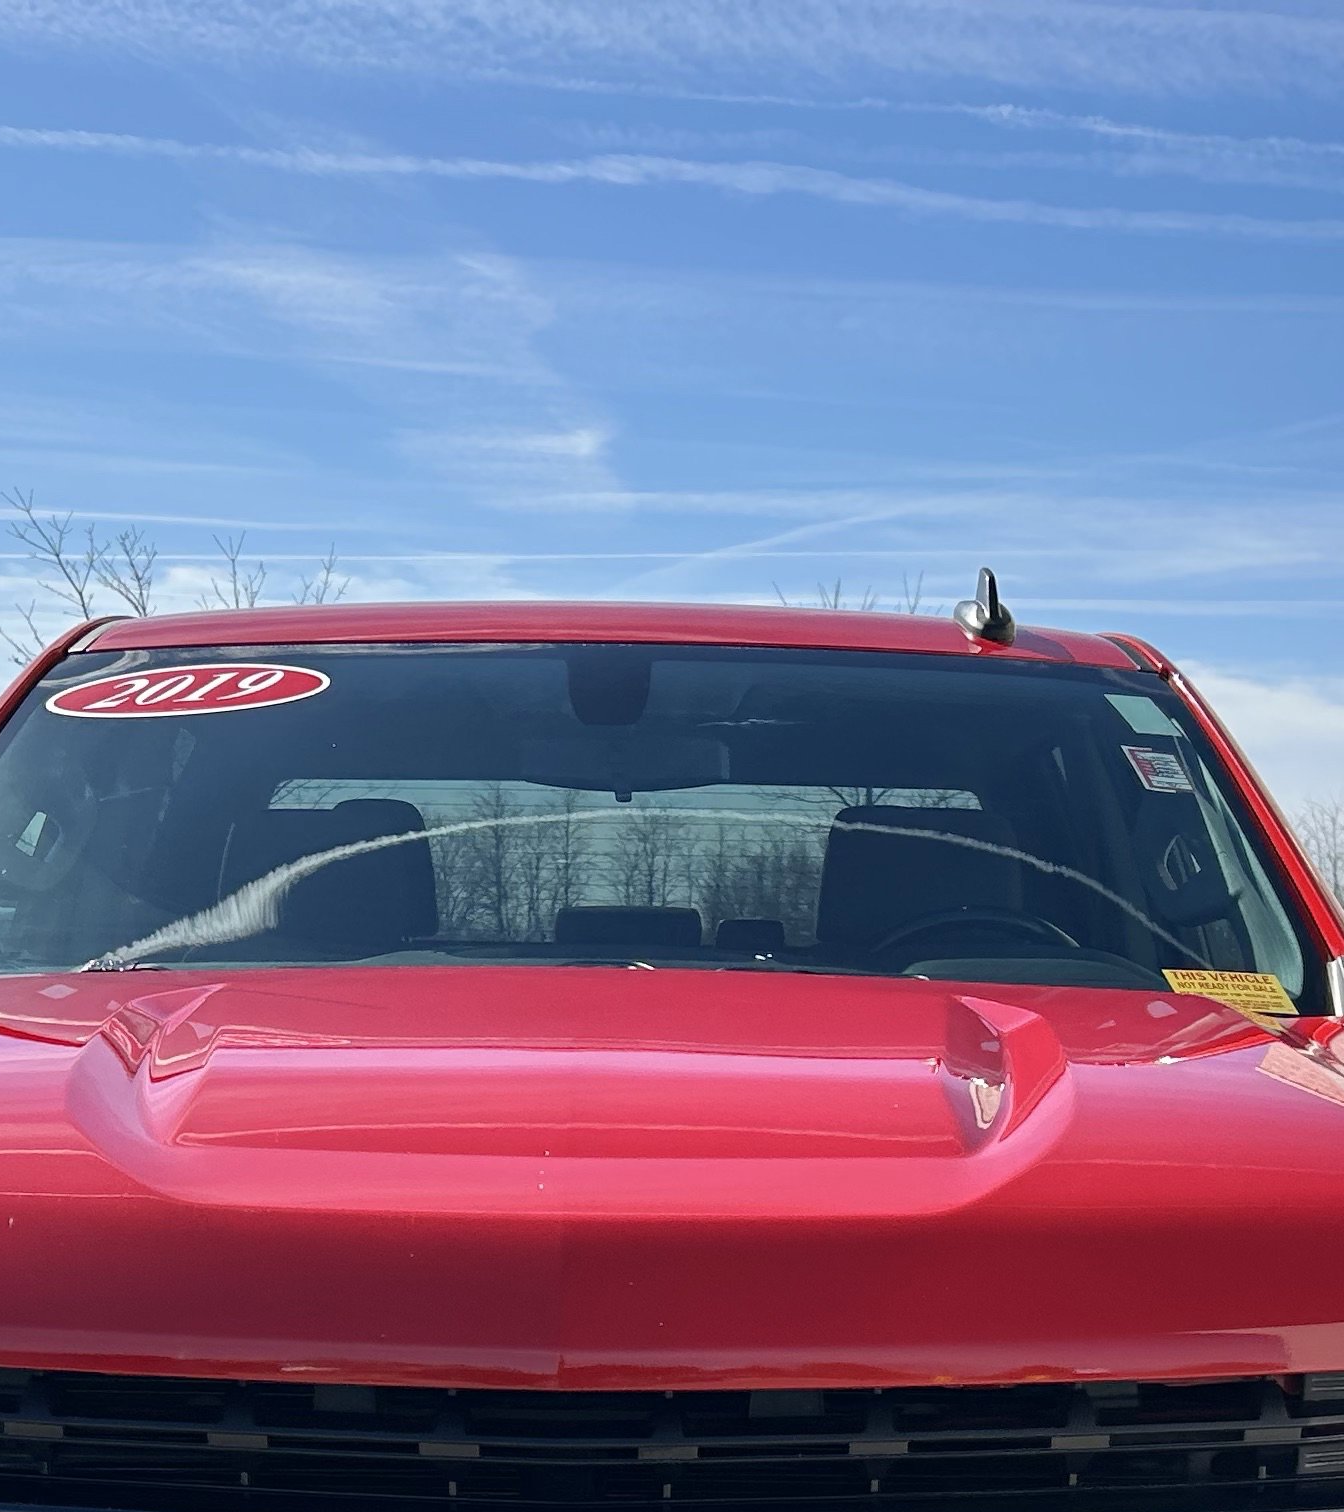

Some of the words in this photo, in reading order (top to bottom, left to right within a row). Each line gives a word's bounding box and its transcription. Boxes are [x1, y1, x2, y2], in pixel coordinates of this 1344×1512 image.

[82, 670, 285, 710] 2019
[1170, 971, 1206, 981] THIS
[1209, 973, 1272, 984] VEHICLE
